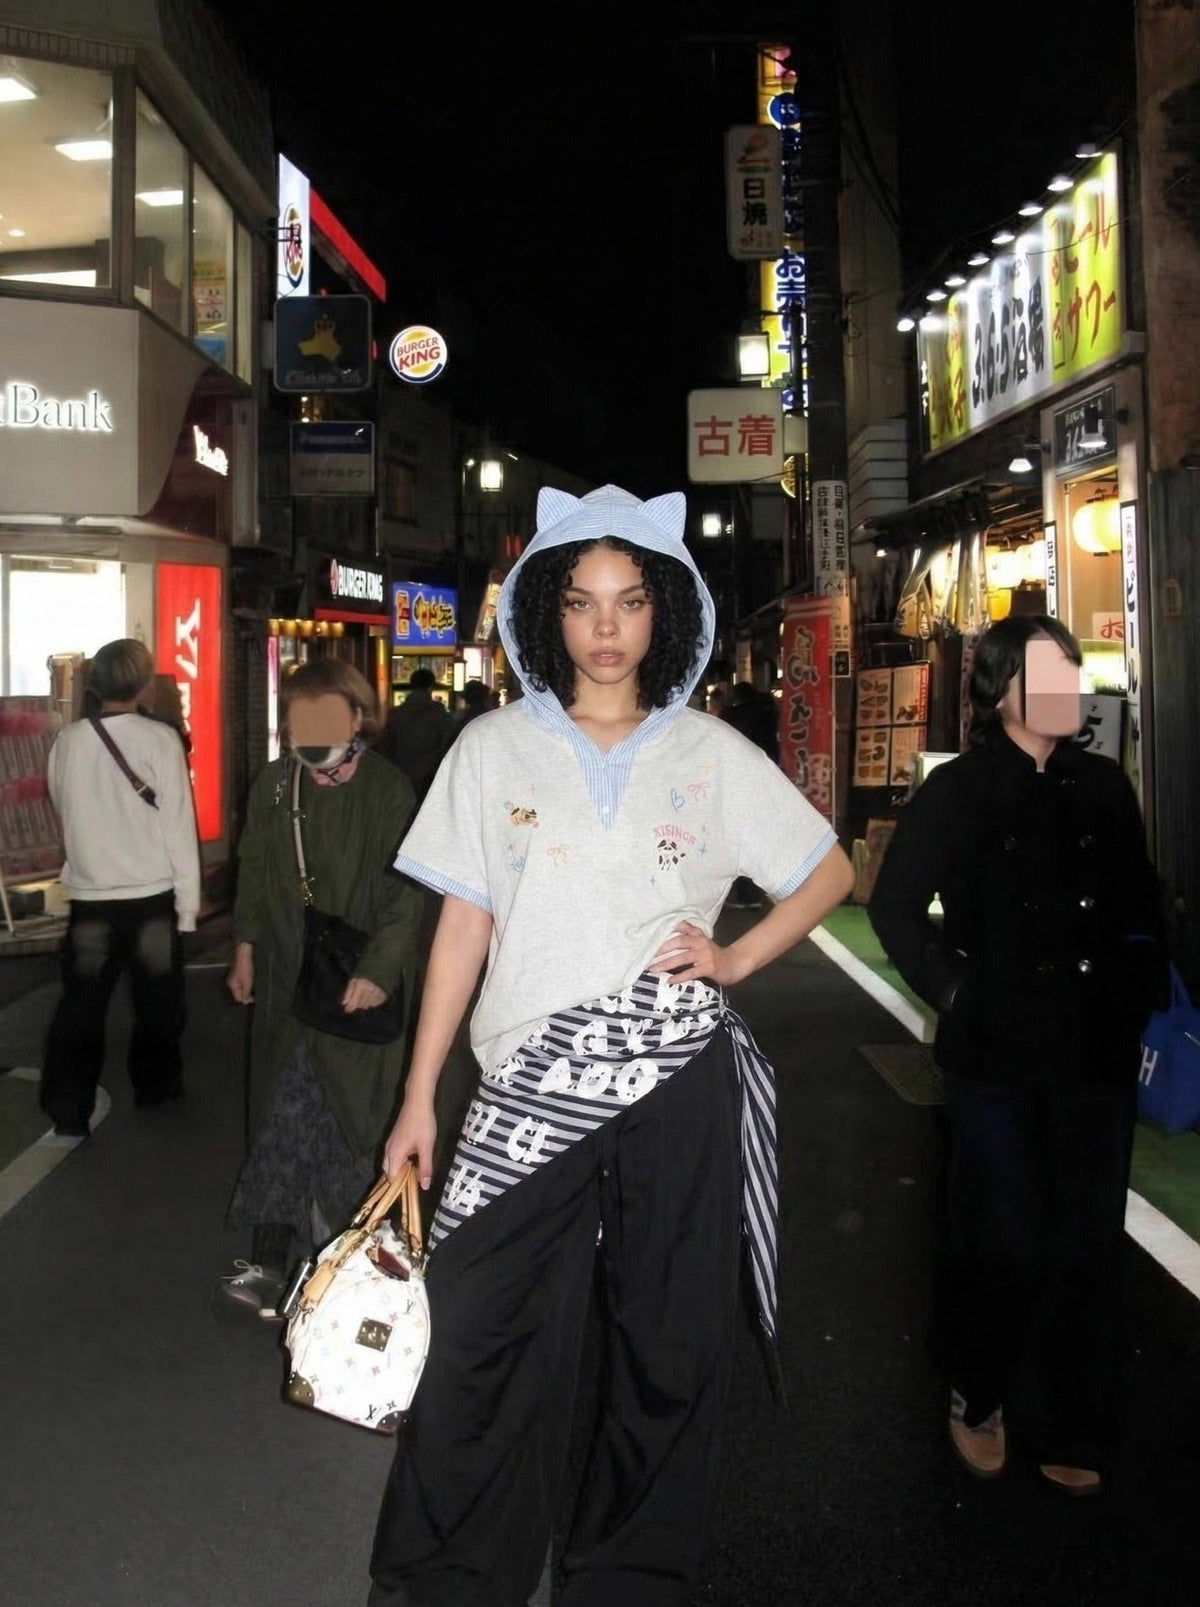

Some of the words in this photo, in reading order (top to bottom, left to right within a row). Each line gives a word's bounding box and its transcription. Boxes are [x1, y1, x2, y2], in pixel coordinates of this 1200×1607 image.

[397, 336, 439, 357] BURGER
[398, 346, 441, 371] KING
[0, 382, 113, 432] Bank
[693, 415, 776, 456] 古着
[338, 564, 367, 599] BURGER
